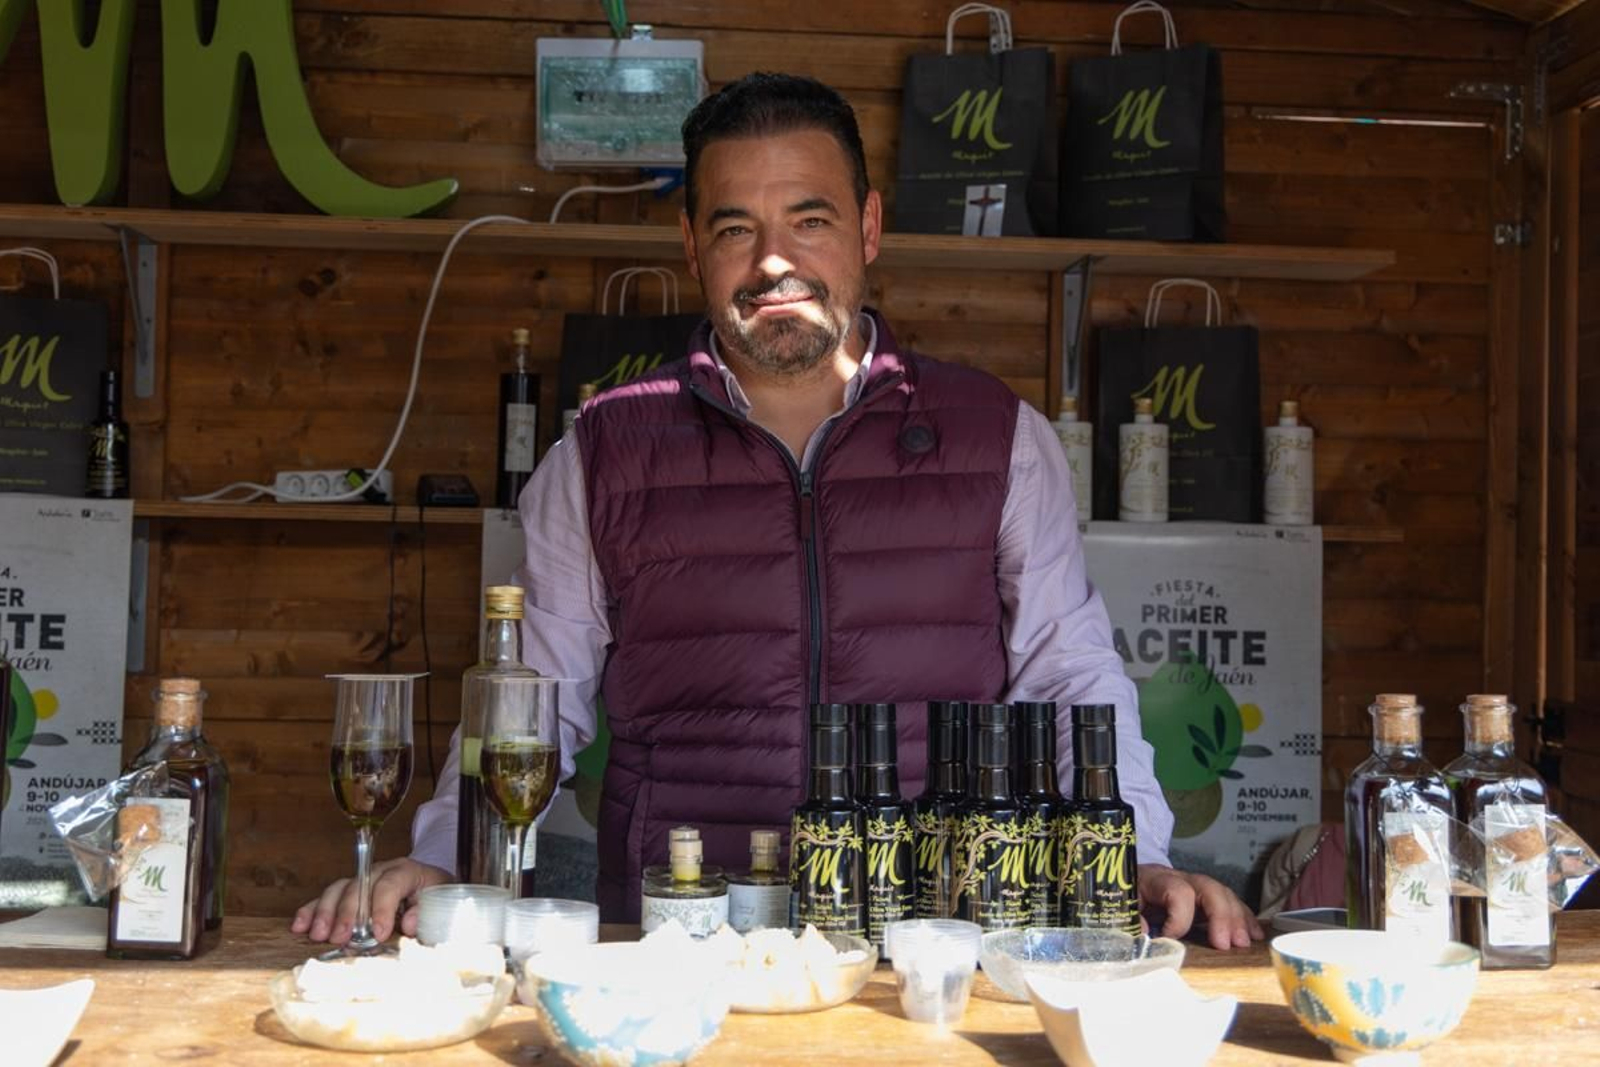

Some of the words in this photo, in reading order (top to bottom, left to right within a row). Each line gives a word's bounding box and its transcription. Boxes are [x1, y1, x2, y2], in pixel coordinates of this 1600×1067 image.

[1141, 604, 1227, 624] PRIMER
[1113, 628, 1266, 666] ACEITE
[1197, 653, 1257, 695] Jaén
[27, 791, 60, 802] 9-10
[1237, 800, 1267, 811] 9-10
[1236, 814, 1297, 822] NOVIEMBRE
